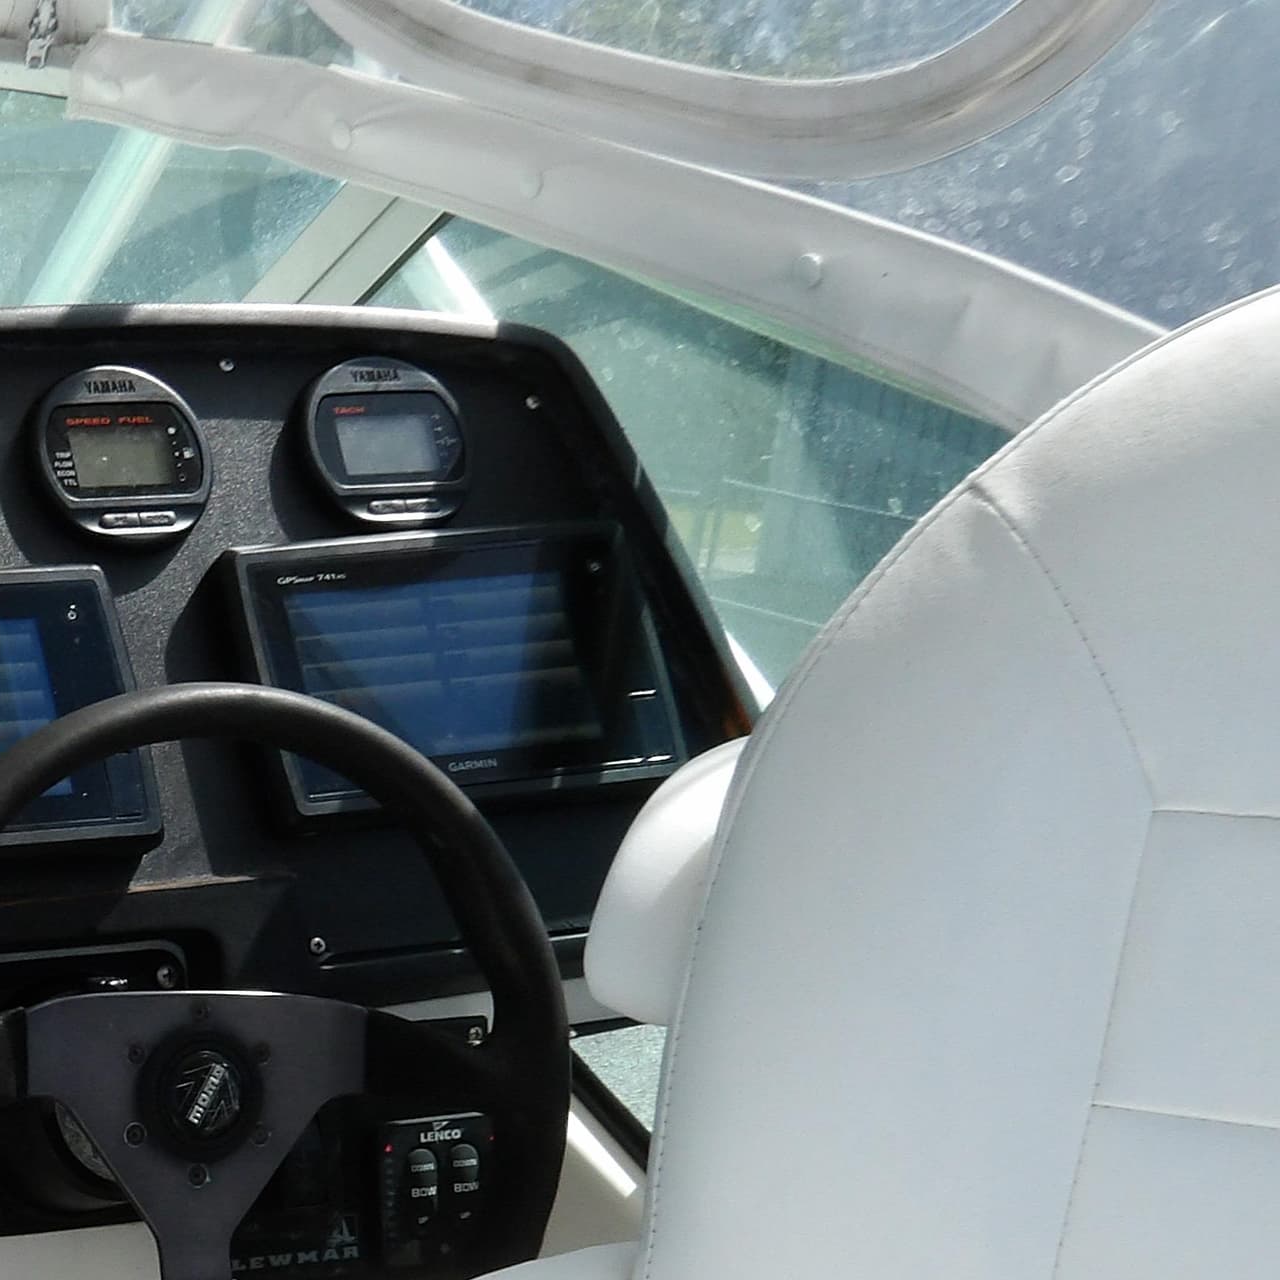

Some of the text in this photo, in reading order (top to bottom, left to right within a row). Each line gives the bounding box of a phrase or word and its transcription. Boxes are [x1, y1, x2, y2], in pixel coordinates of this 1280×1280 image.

[350, 370, 402, 382] YAMAHA
[84, 380, 136, 393] YAMAHA
[65, 416, 154, 426] SPEED FUEL
[448, 758, 498, 772] GARMIN
[420, 1129, 462, 1143] LENCO
[411, 1186, 437, 1198] BOW
[454, 1182, 479, 1193] BOW
[232, 1246, 359, 1271] LEWMAR
